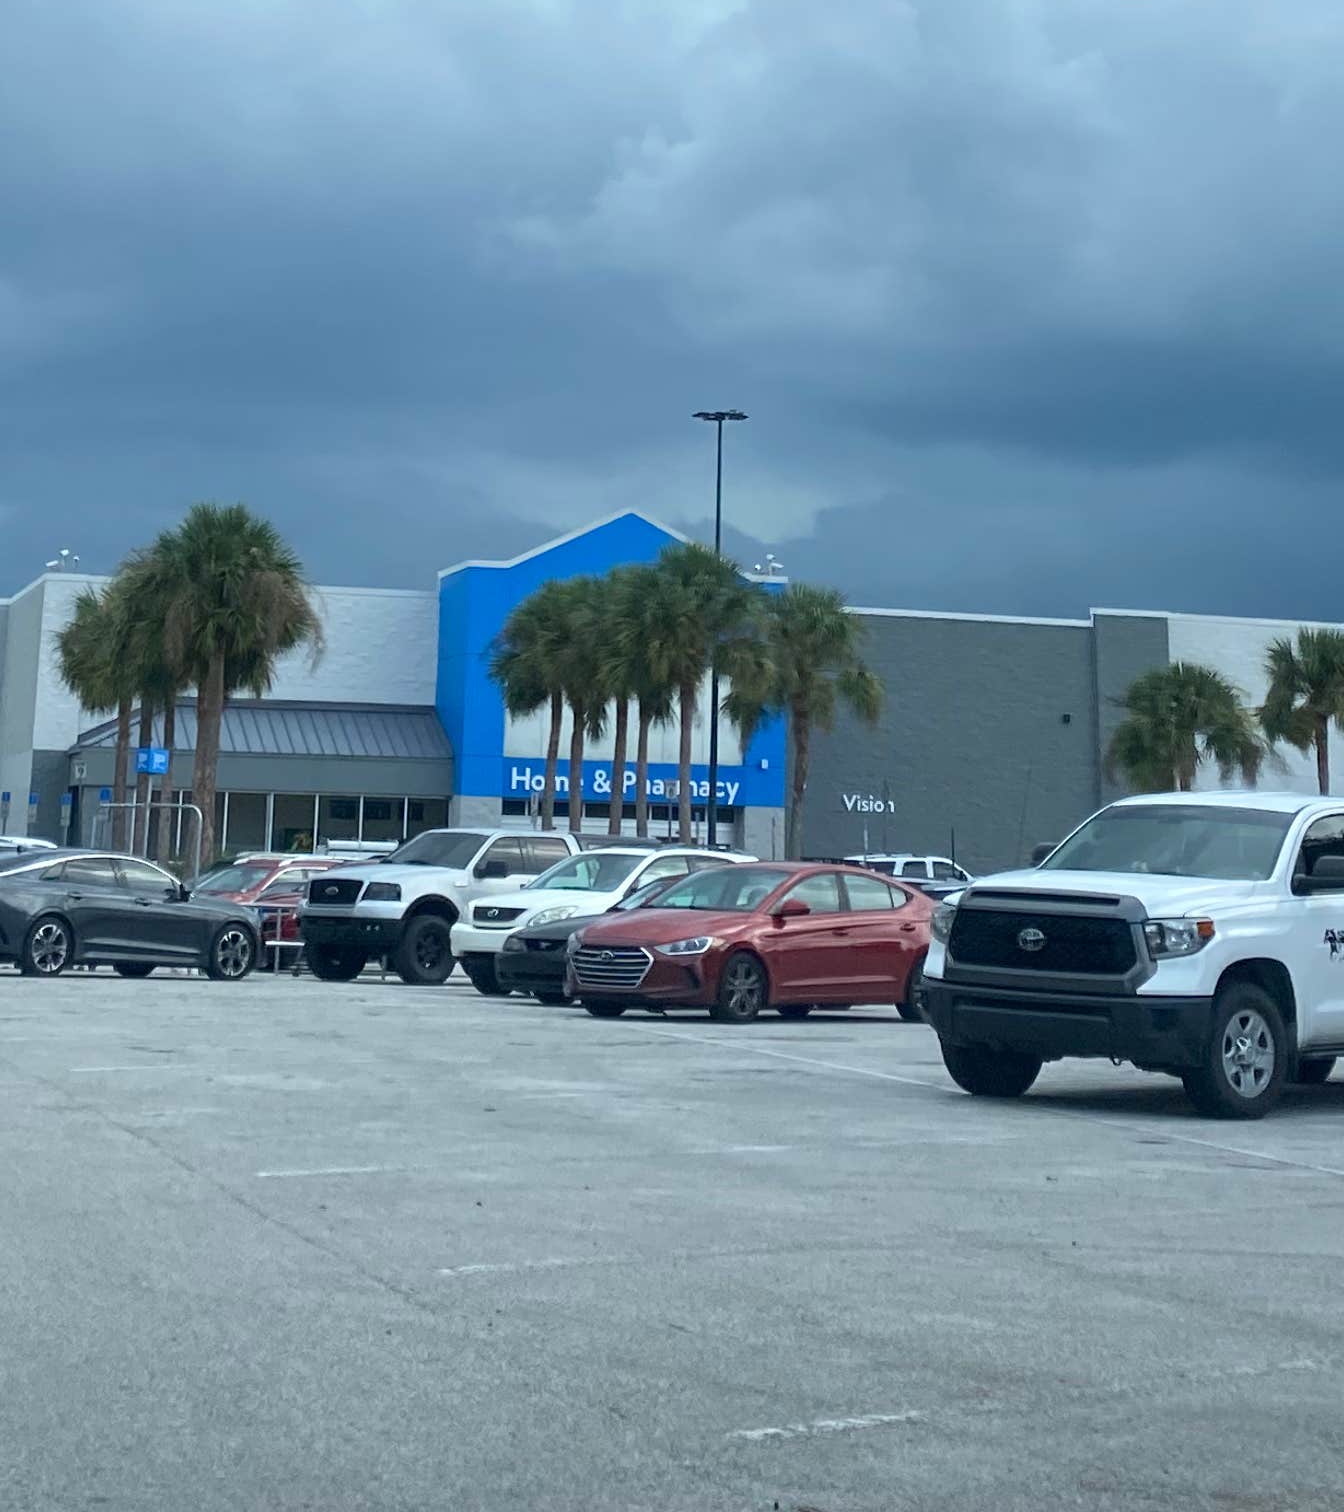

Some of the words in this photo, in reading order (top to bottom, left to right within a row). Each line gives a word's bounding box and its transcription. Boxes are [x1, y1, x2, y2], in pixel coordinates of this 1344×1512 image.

[511, 766, 584, 793] Hom
[592, 769, 612, 794] &
[622, 770, 740, 806] Pamacy
[843, 793, 896, 814] Vision
